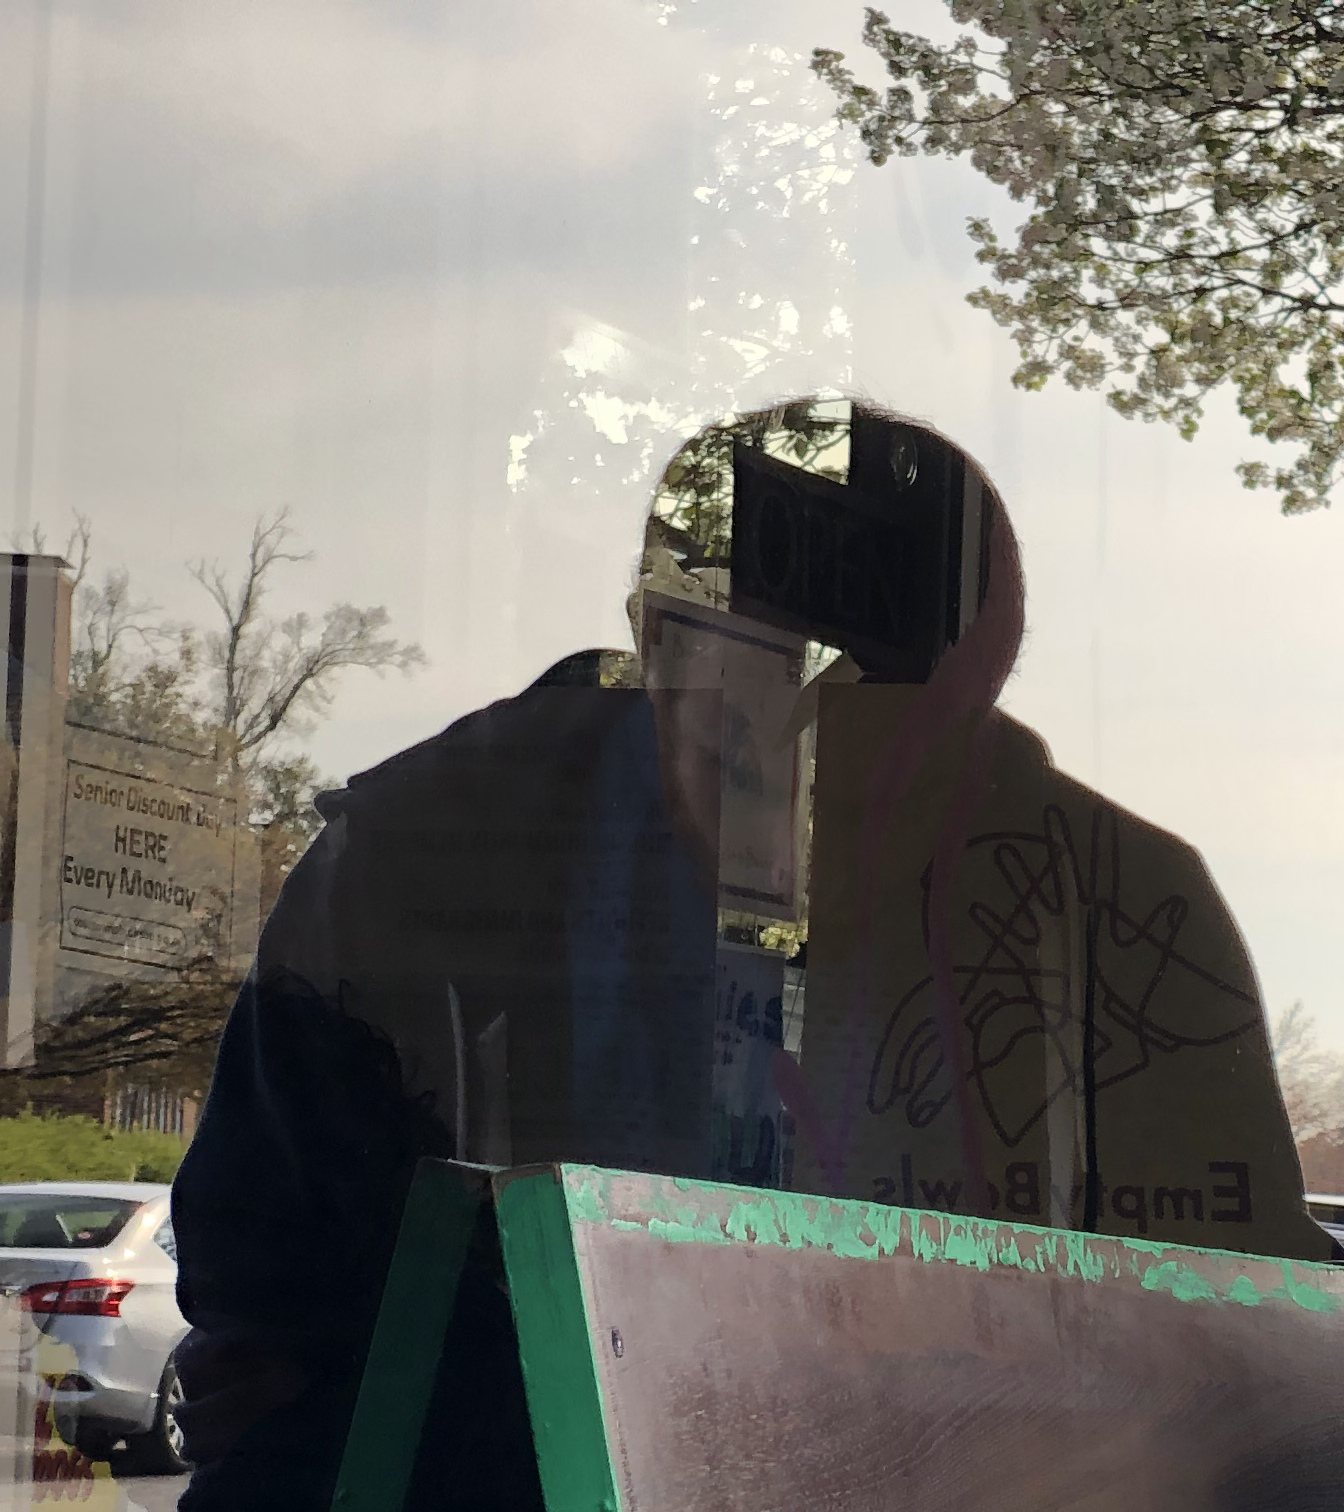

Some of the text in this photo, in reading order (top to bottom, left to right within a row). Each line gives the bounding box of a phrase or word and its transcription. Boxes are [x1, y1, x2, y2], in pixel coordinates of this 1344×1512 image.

[74, 774, 124, 809] Senior
[126, 786, 191, 823] Discount
[114, 824, 169, 864] HERE
[63, 854, 196, 912] Every Monday
